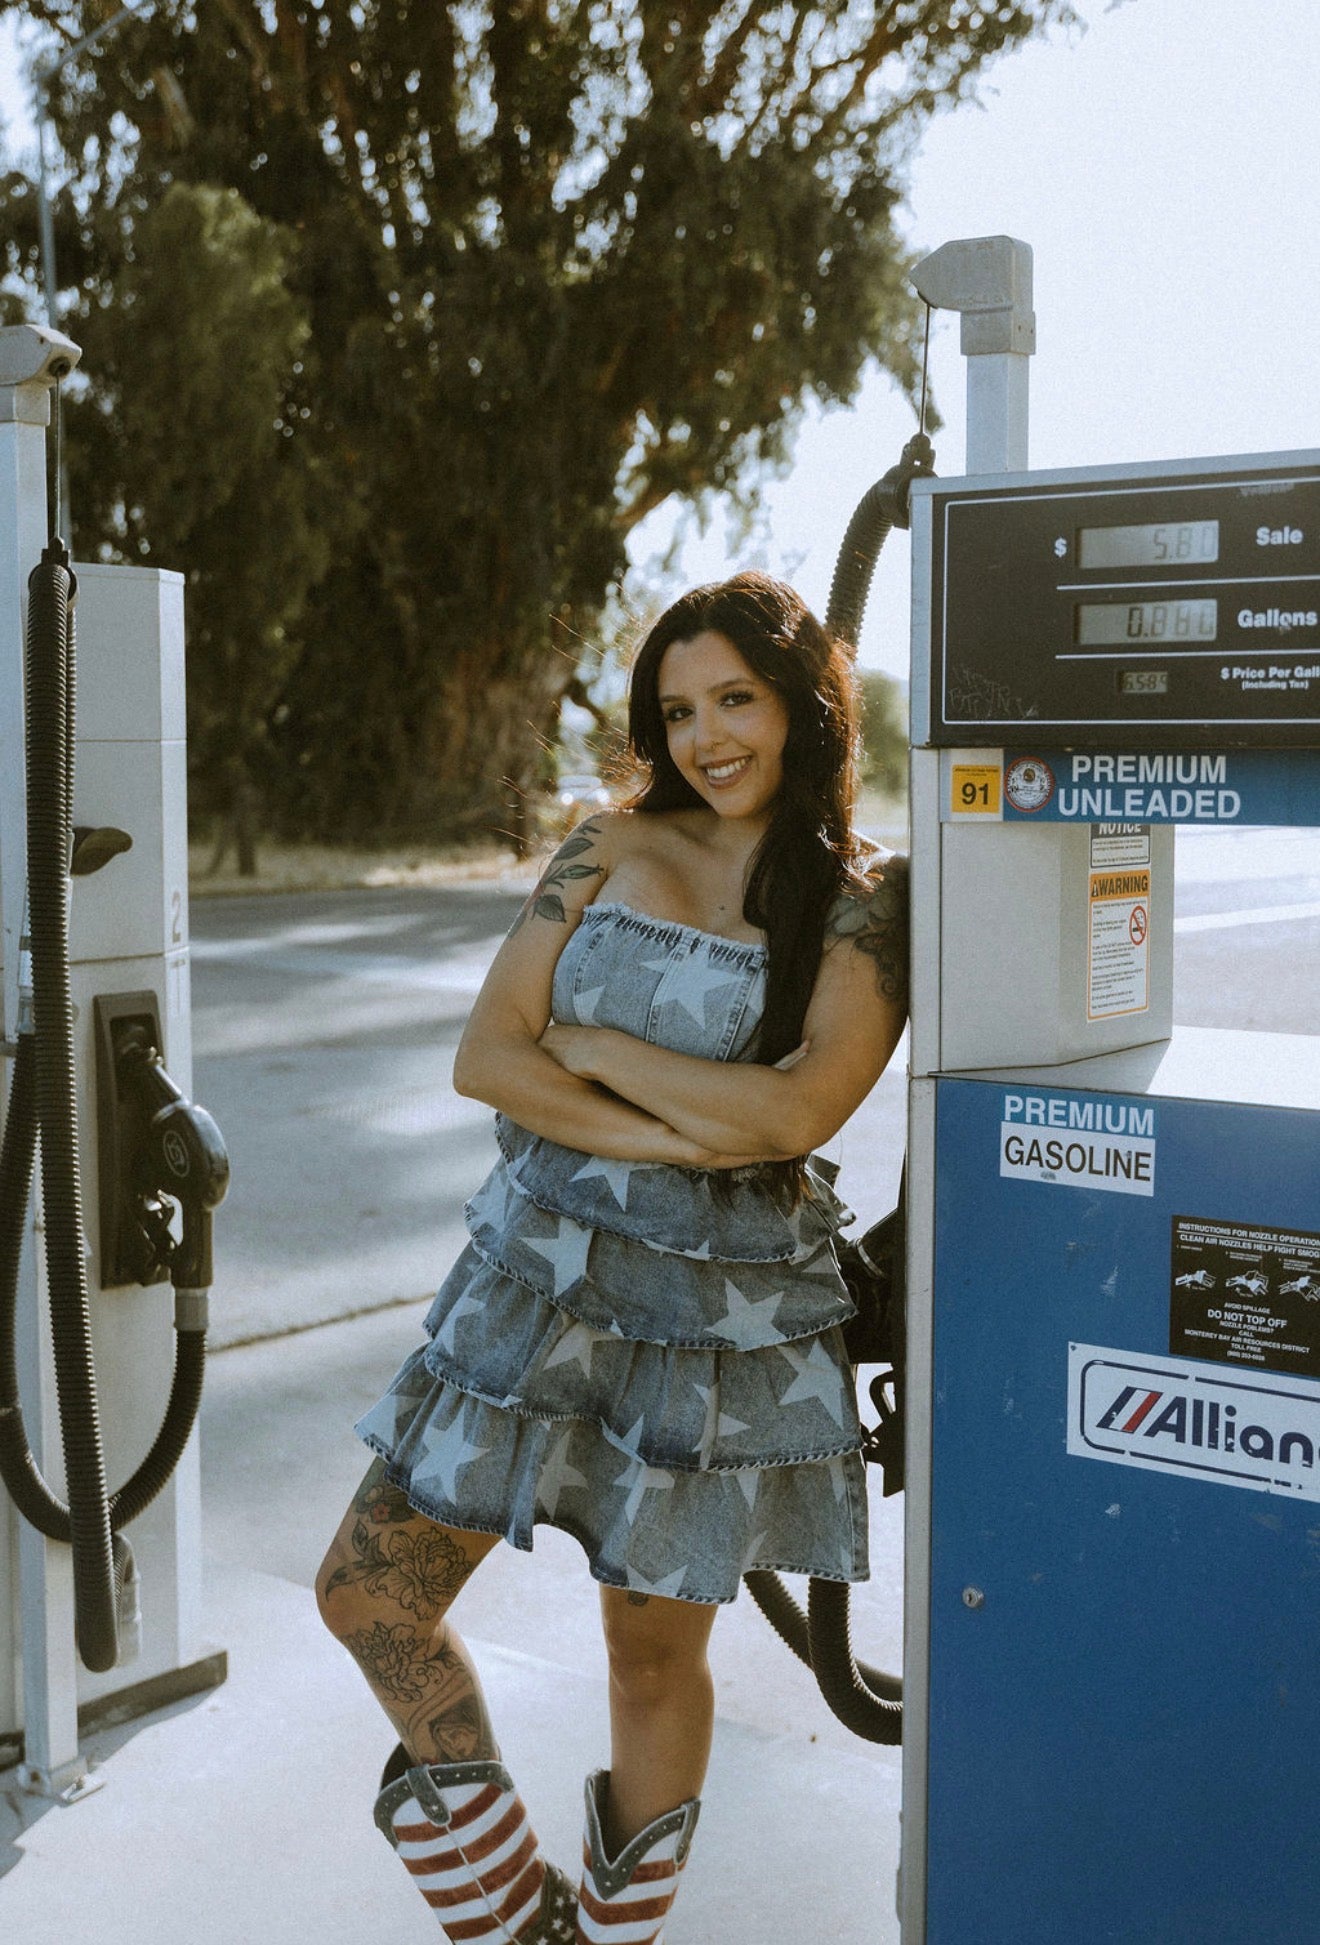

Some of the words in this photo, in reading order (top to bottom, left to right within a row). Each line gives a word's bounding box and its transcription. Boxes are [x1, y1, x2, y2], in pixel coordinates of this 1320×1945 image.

[1256, 526, 1304, 546] Sale
[1054, 537, 1067, 558] $
[1237, 608, 1318, 628] Gallons
[1221, 667, 1230, 680] $
[1232, 666, 1265, 679] Price
[1268, 666, 1291, 678] Per
[1072, 755, 1227, 784] PREMIUM
[961, 782, 989, 805] 91
[1058, 789, 1241, 818] UNLEADED
[1099, 823, 1142, 836] NOTICE
[1099, 874, 1149, 896] WARNING
[1004, 1094, 1154, 1136] PREMIUM
[1004, 1135, 1152, 1182] GASOLINE
[1178, 1222, 1231, 1236] INSTRUCTIONS
[1232, 1228, 1248, 1238] FOR
[1249, 1230, 1278, 1241] NOZZLE
[1180, 1234, 1204, 1244] CLEAN
[1205, 1237, 1218, 1245] AIR
[1219, 1239, 1252, 1249] NOZZLES
[1253, 1243, 1273, 1252] HELP
[1274, 1246, 1296, 1255] FIGHT
[1207, 1308, 1222, 1319] DO
[1224, 1311, 1244, 1322] NOT
[1246, 1314, 1266, 1325] TOP
[1267, 1317, 1288, 1328] OFF
[1224, 1302, 1241, 1311] AVOID
[1242, 1304, 1270, 1315] SPILLAGE
[1219, 1320, 1242, 1330] NOZZLE
[1238, 1329, 1254, 1338] CALL
[1184, 1328, 1217, 1340] MONTEREY
[1218, 1333, 1231, 1341] BAY
[1232, 1335, 1242, 1343] AIR
[1243, 1336, 1280, 1349] RESOURCES
[1281, 1342, 1310, 1354] DISTRICT
[1231, 1342, 1246, 1351] TOLL
[1246, 1344, 1262, 1353] FREE
[1143, 1395, 1320, 1468] Allian
